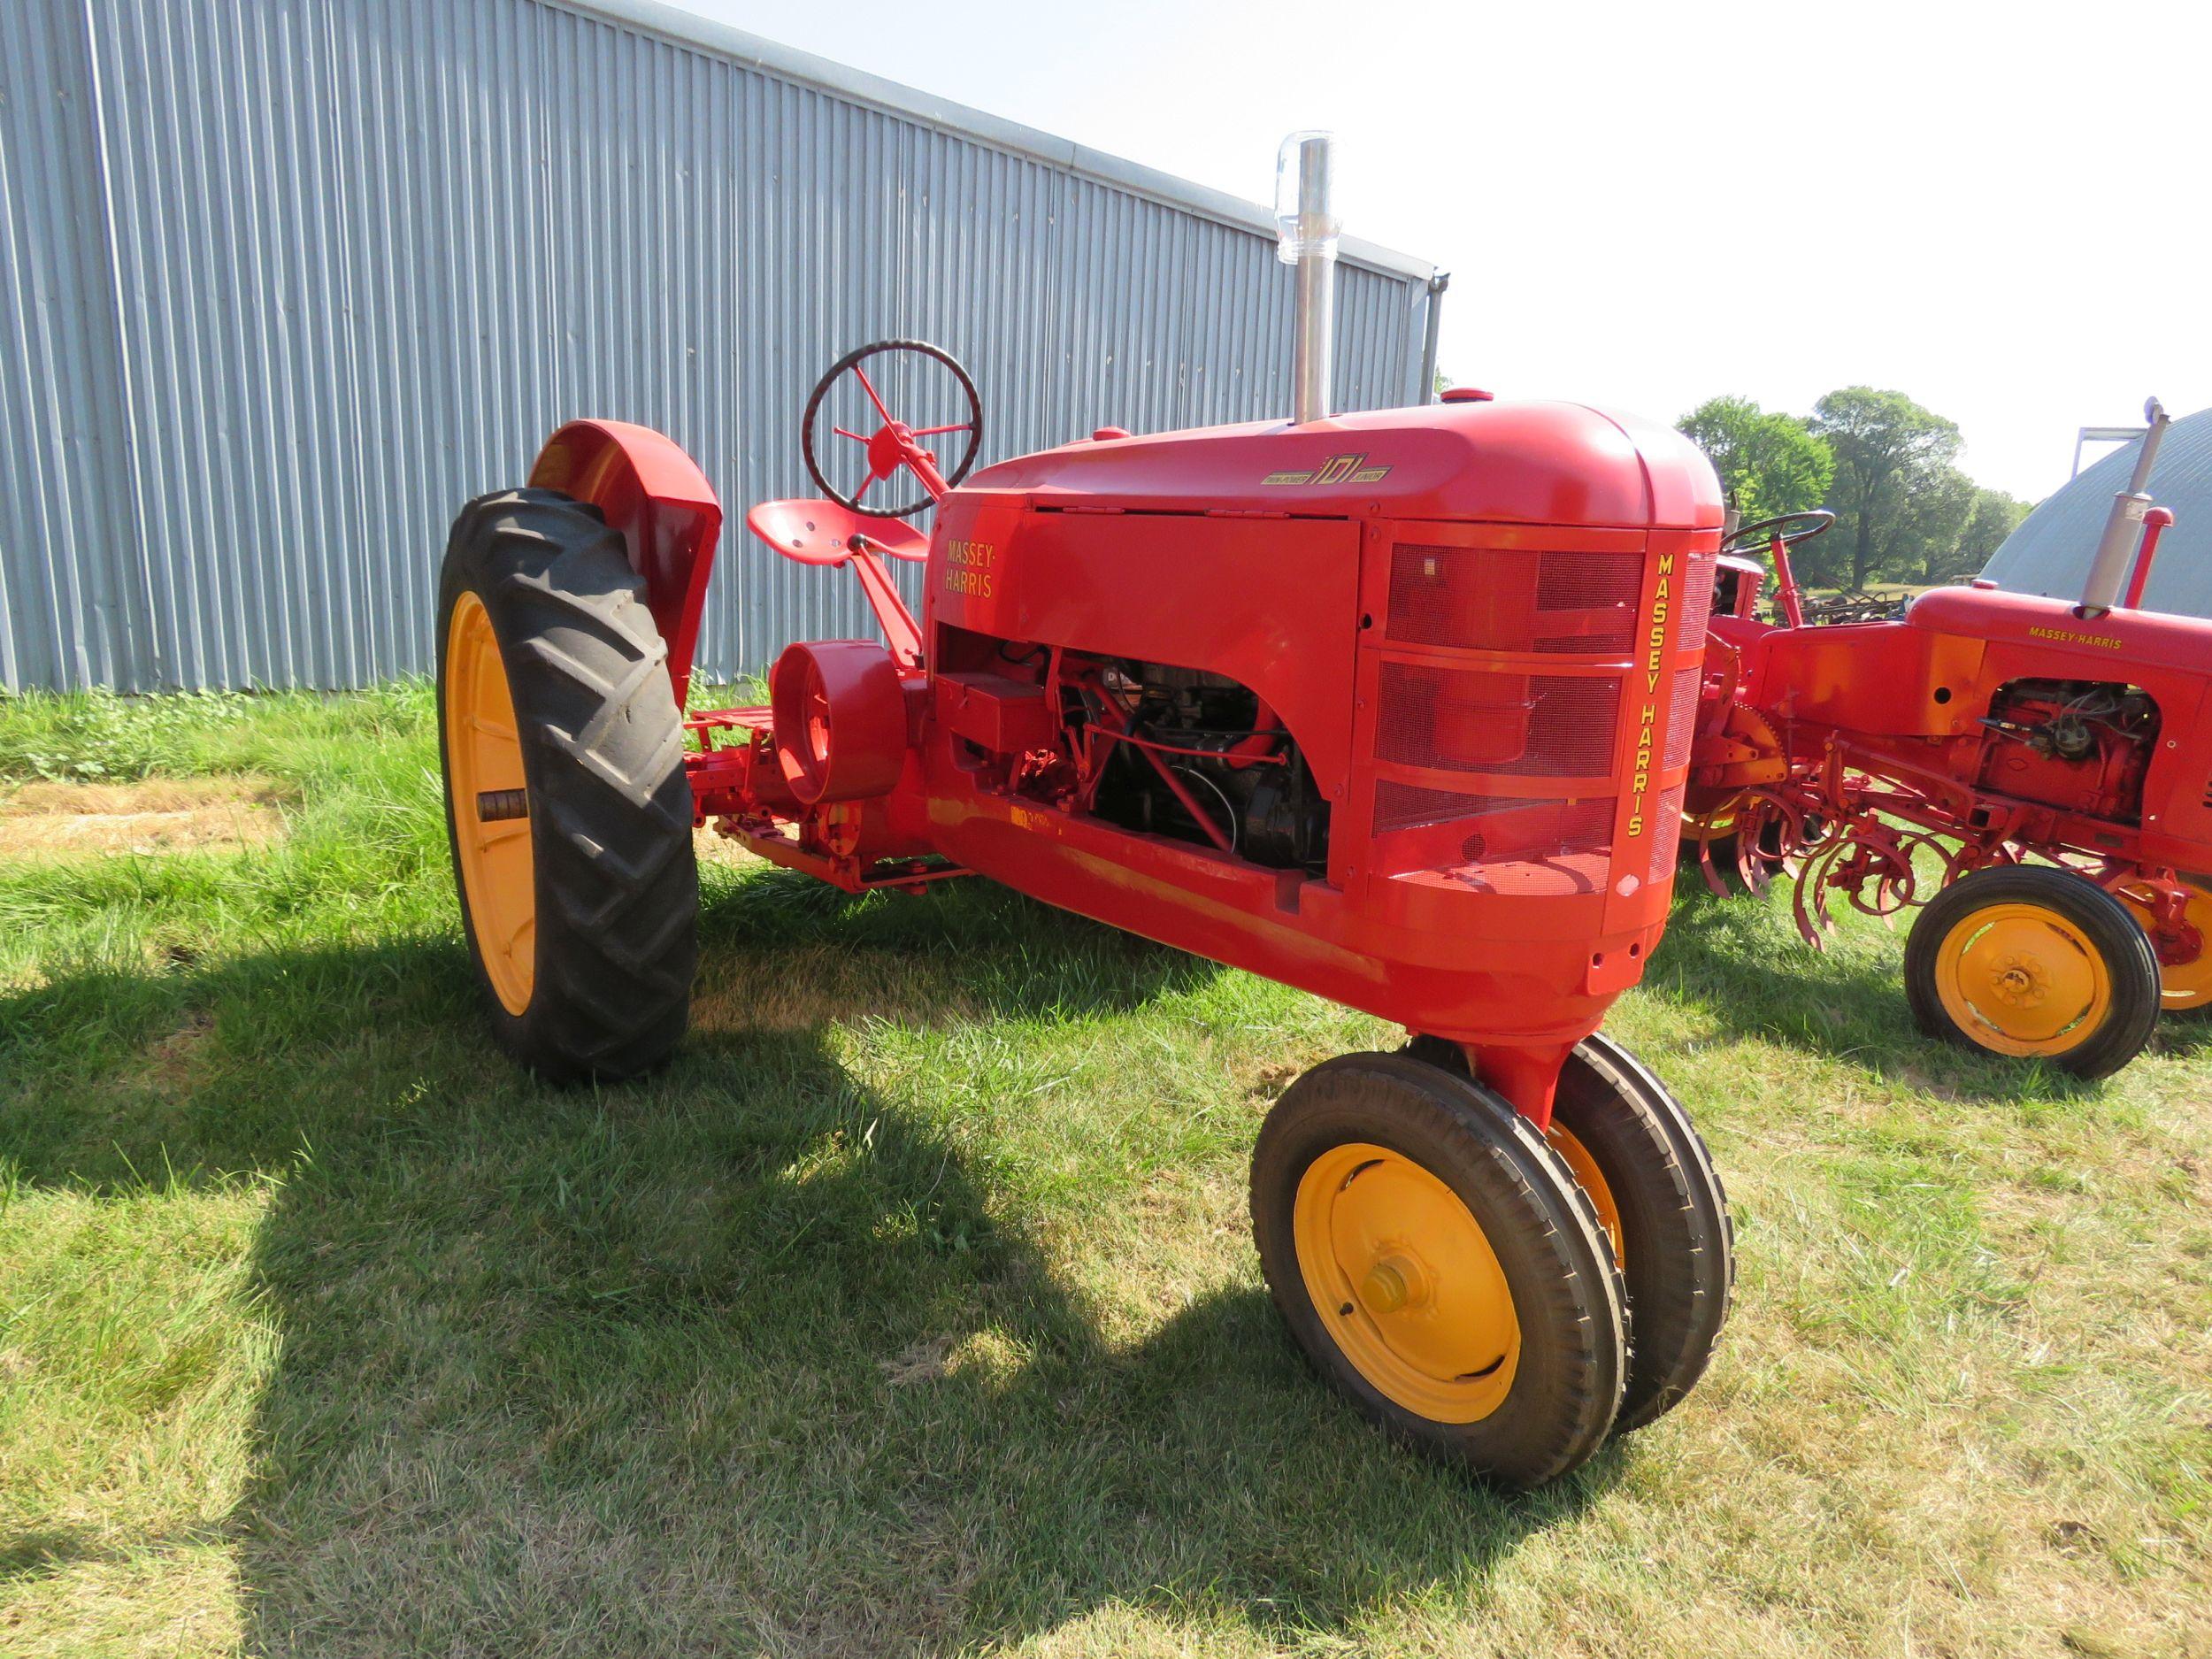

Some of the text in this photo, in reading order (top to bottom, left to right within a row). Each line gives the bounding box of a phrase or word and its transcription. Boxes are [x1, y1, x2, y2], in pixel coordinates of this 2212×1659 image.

[945, 569, 991, 598] HARRIS
[1627, 553, 1675, 837] MASSEY HARRIS
